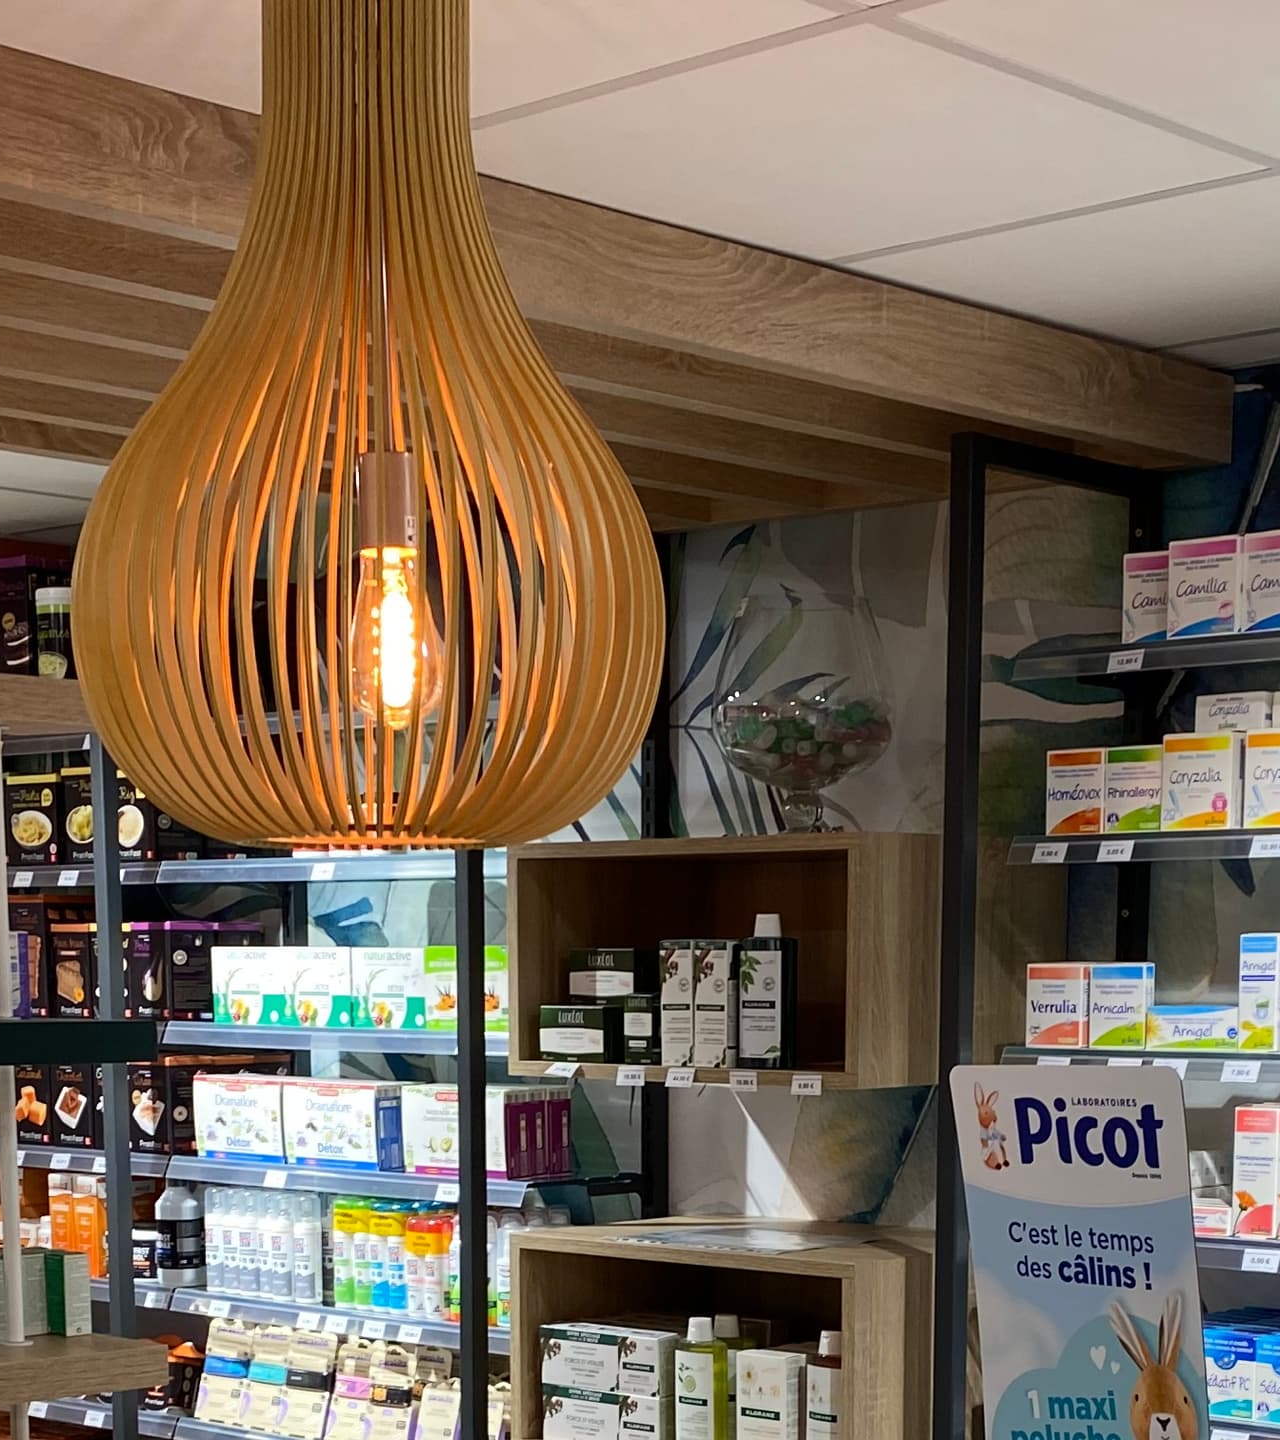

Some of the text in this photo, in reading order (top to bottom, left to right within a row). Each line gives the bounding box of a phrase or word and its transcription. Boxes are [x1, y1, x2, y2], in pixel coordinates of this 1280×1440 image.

[1176, 580, 1227, 598] Camilia
[1171, 769, 1222, 787] Coryzalia
[1107, 786, 1161, 799] Rhinallergy
[1241, 960, 1277, 973] Arnigel
[1031, 1000, 1077, 1014] Verrulia
[1092, 1002, 1135, 1015] Arnicalm
[1173, 1024, 1213, 1041] Arnigel
[1071, 1098, 1137, 1107] LABORATOIRES
[1014, 1097, 1163, 1169] Picot
[1008, 1222, 1154, 1254] C'est le temps
[1016, 1255, 1052, 1280] des
[1058, 1253, 1136, 1289] câlins
[1027, 1389, 1116, 1421] 1 maxi
